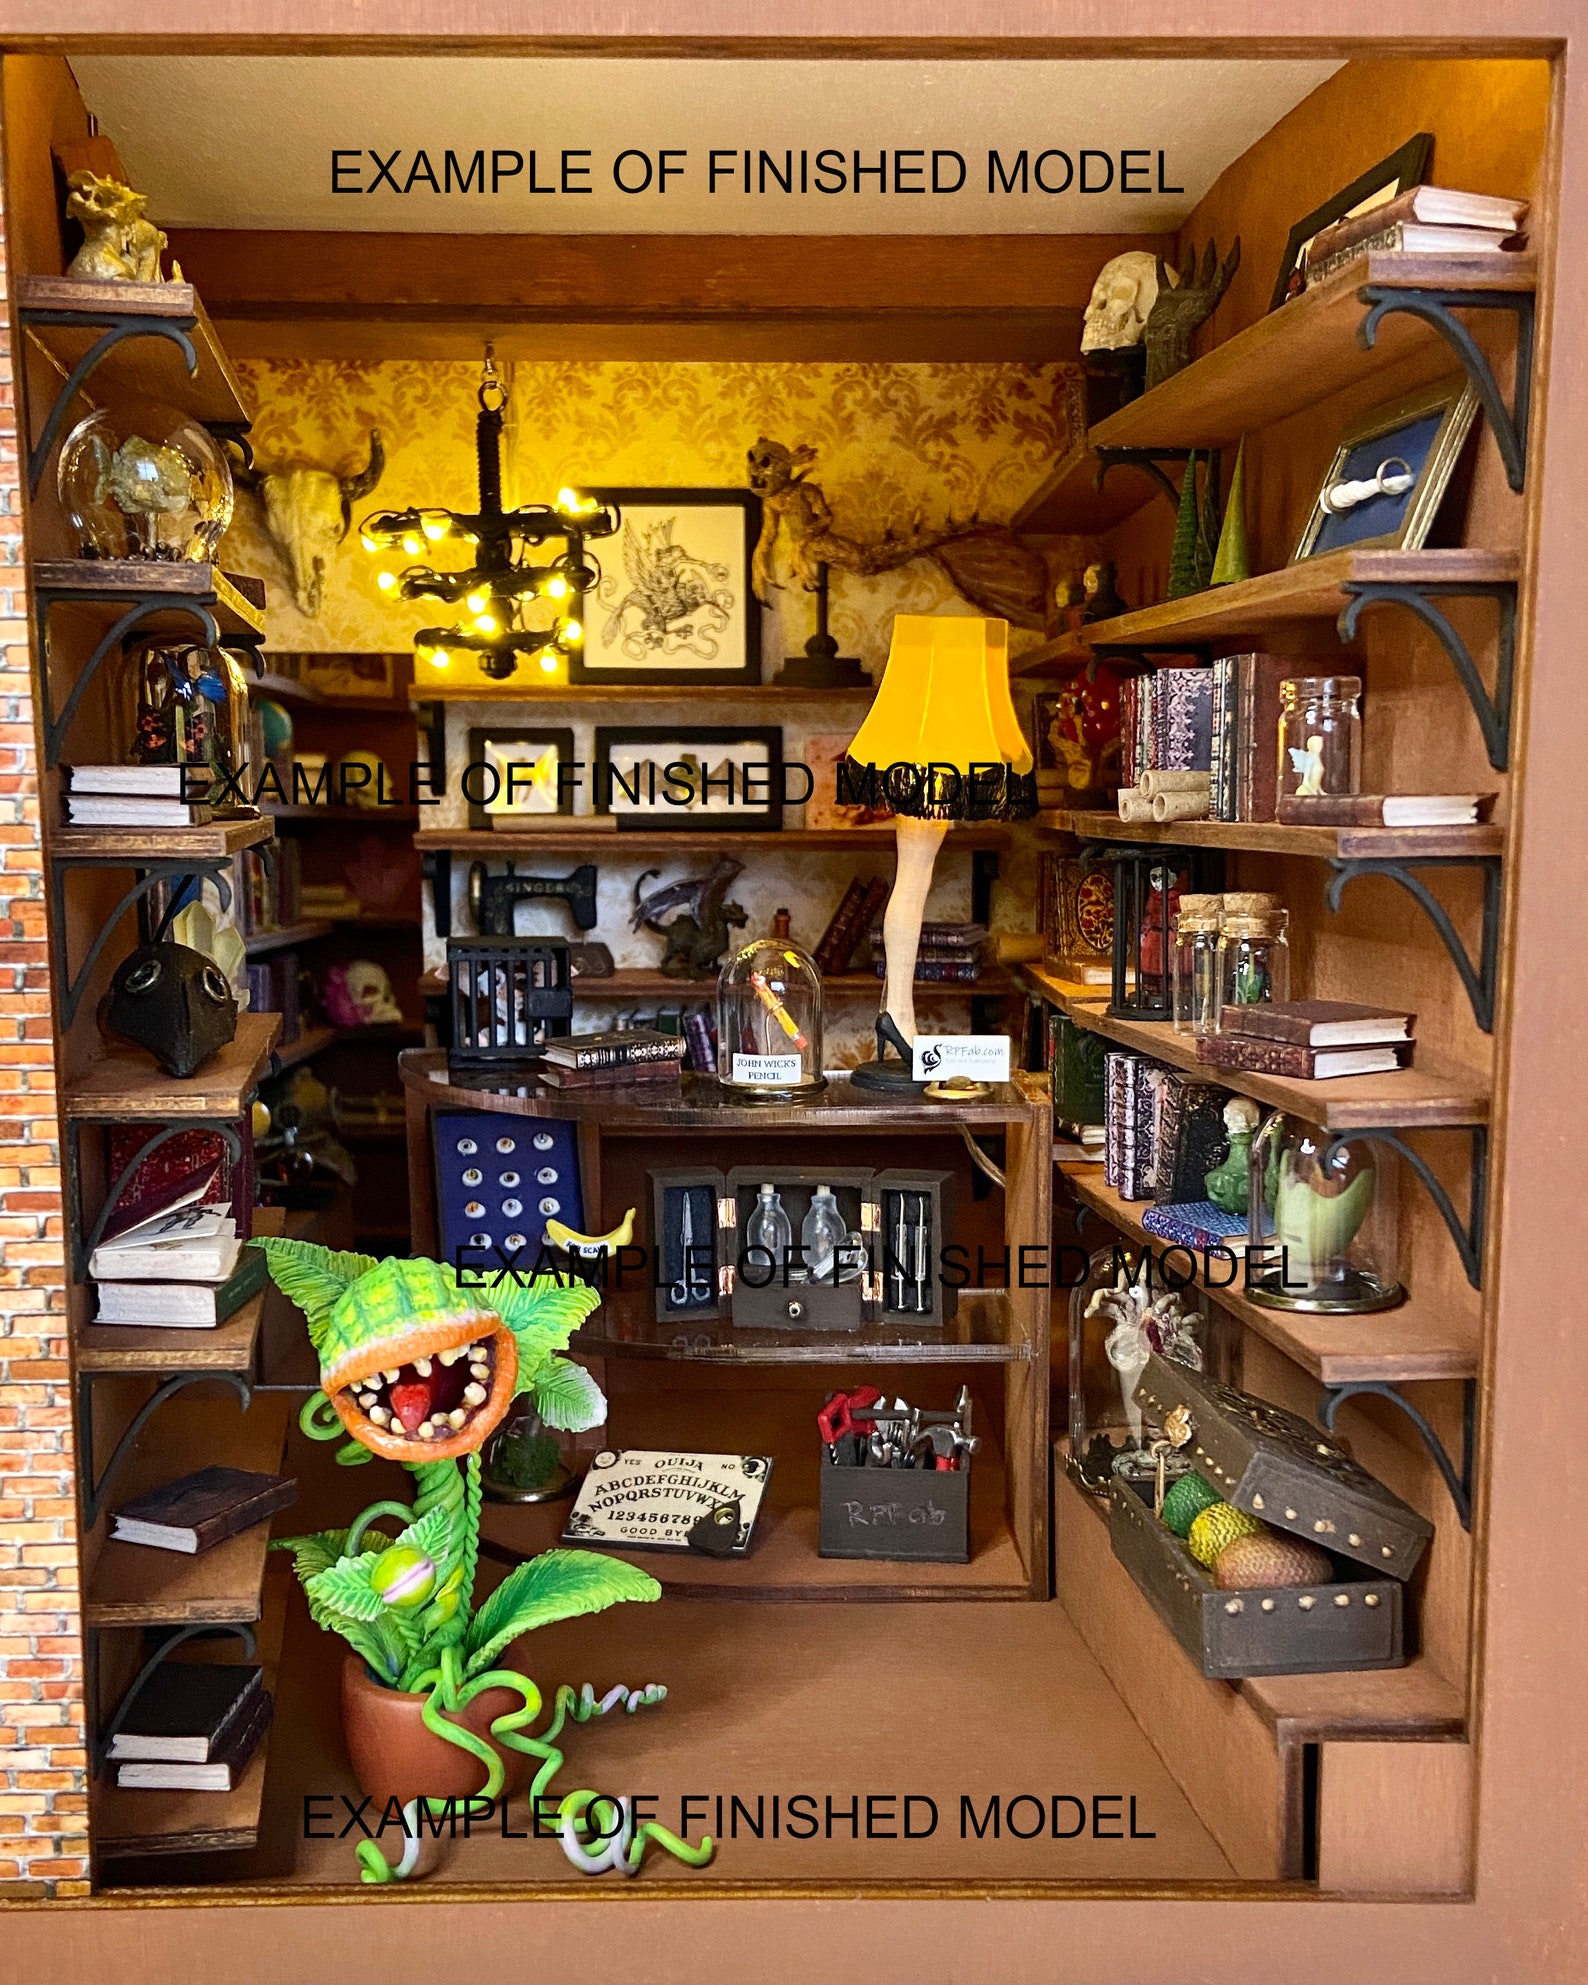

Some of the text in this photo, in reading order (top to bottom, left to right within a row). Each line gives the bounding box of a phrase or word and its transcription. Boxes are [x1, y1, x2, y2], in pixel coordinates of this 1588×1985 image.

[737, 1059, 761, 1067] JOHN
[749, 1072, 782, 1080] PENCIL
[624, 1458, 642, 1466] YES
[654, 1457, 704, 1471] OUIJA
[620, 1526, 657, 1536] GOOD
